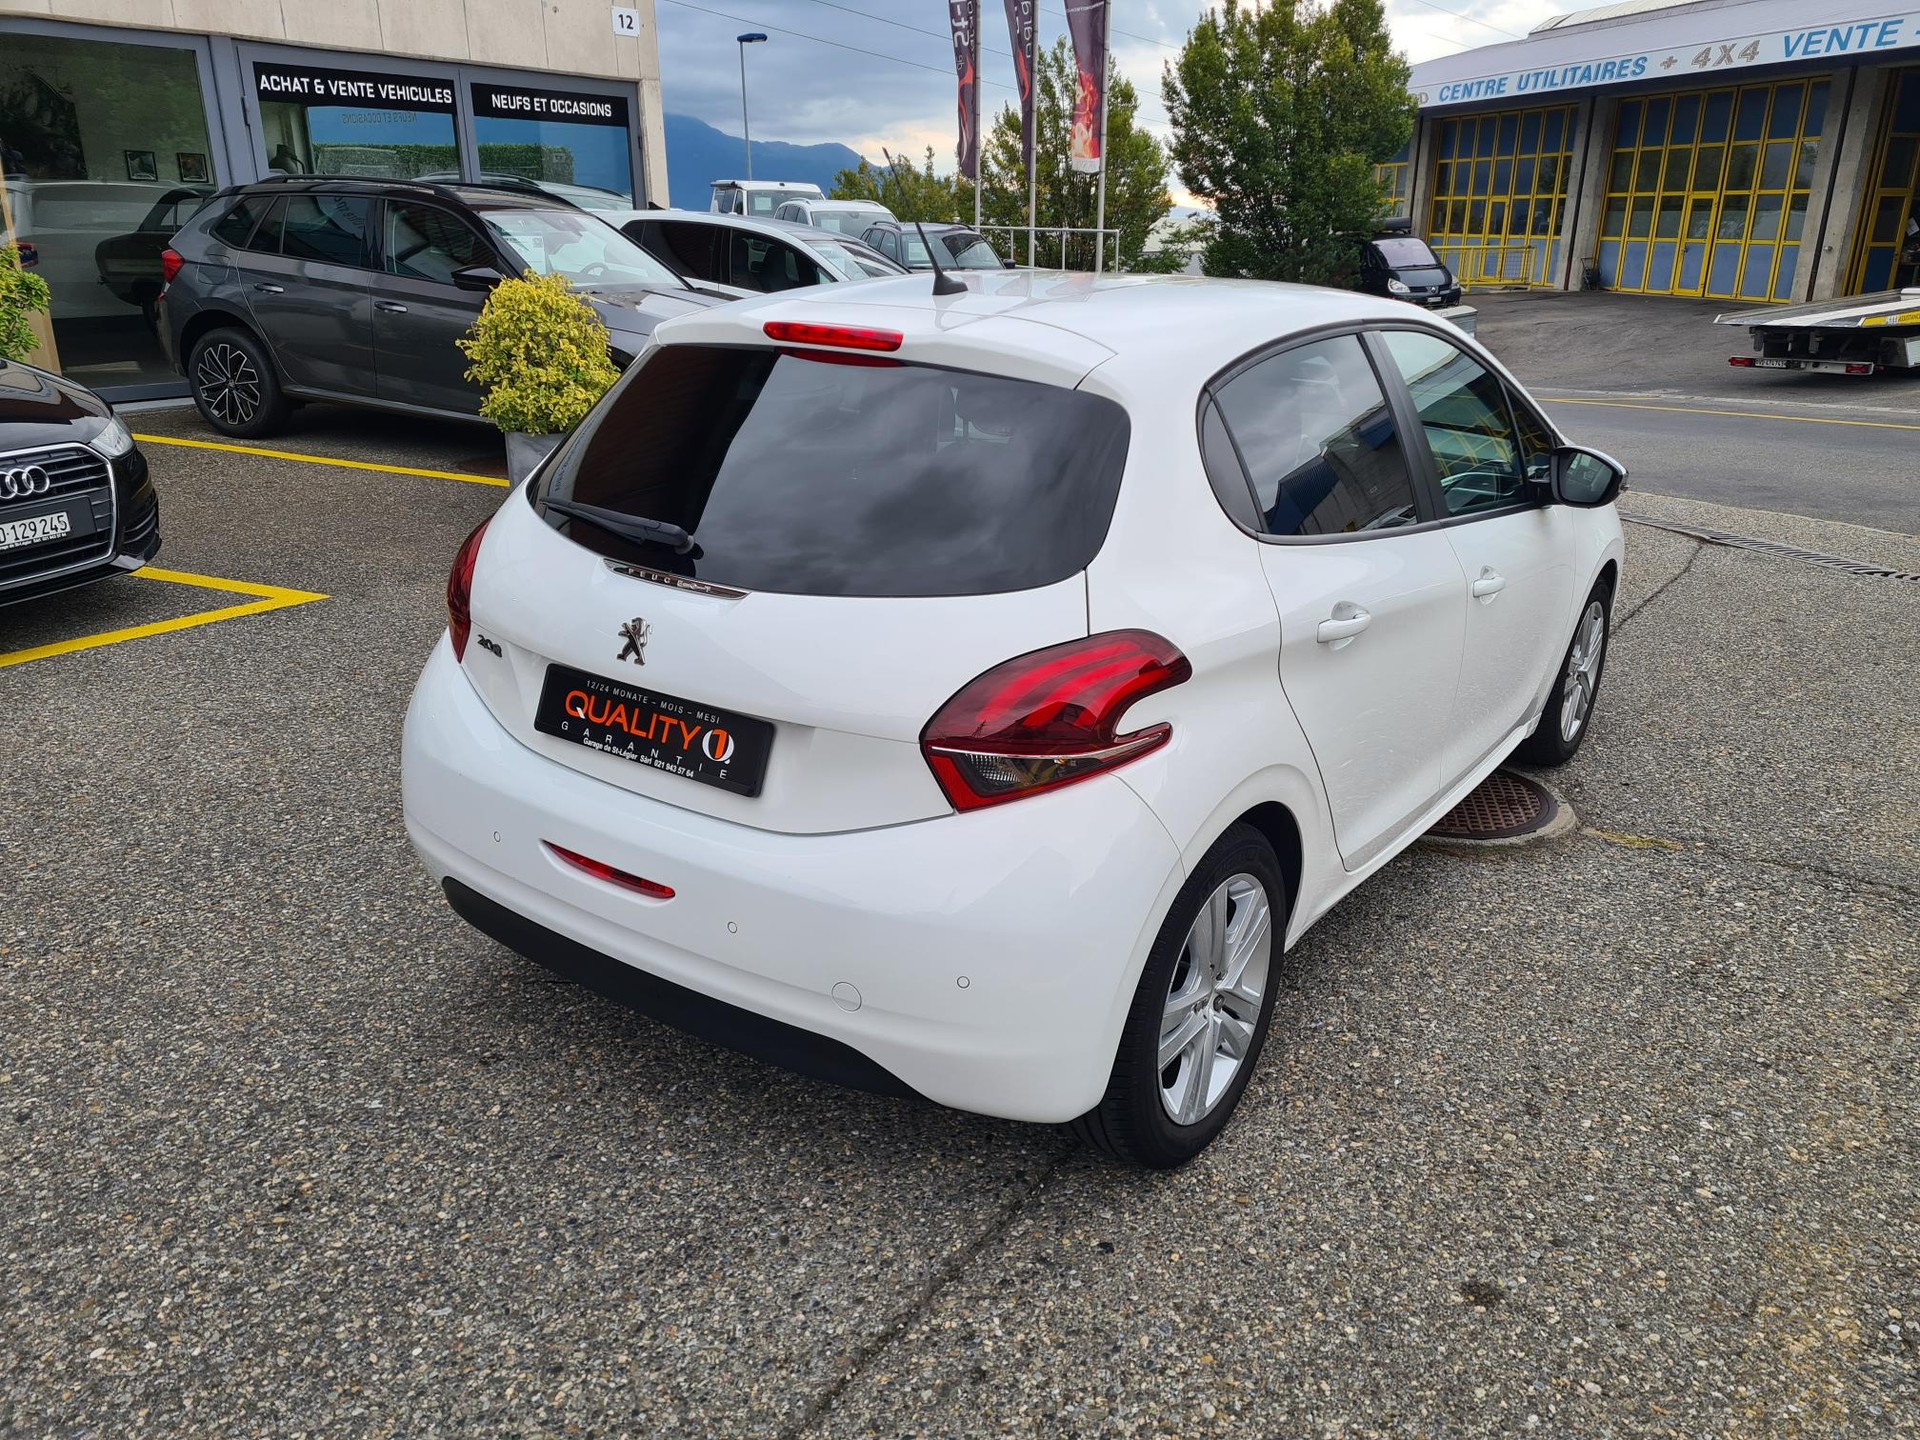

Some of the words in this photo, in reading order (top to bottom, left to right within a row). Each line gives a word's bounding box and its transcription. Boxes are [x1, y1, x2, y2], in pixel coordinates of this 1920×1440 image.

[618, 14, 634, 30] 12
[1439, 77, 1509, 102] CENTRE
[1517, 56, 1648, 92] UTILITAIRES
[1660, 55, 1679, 70] +
[1691, 39, 1761, 69] 4X4
[1783, 18, 1905, 59] VENTE
[260, 74, 310, 93] ACHAT
[314, 79, 325, 95] &
[328, 80, 375, 99] VENTE
[378, 83, 452, 104] VEHICULES
[491, 93, 531, 111] NEUFS
[534, 98, 547, 112] ET
[550, 99, 612, 118] OCCASIONS
[628, 568, 711, 592] PEUGEOT
[586, 680, 609, 692] 12/24
[612, 687, 649, 704] MONATE
[660, 700, 684, 714] MOIS
[696, 710, 721, 724] MESI
[565, 689, 702, 751] QUALITY
[583, 737, 603, 751] Garage
[603, 743, 611, 752] de
[653, 759, 665, 769] 021
